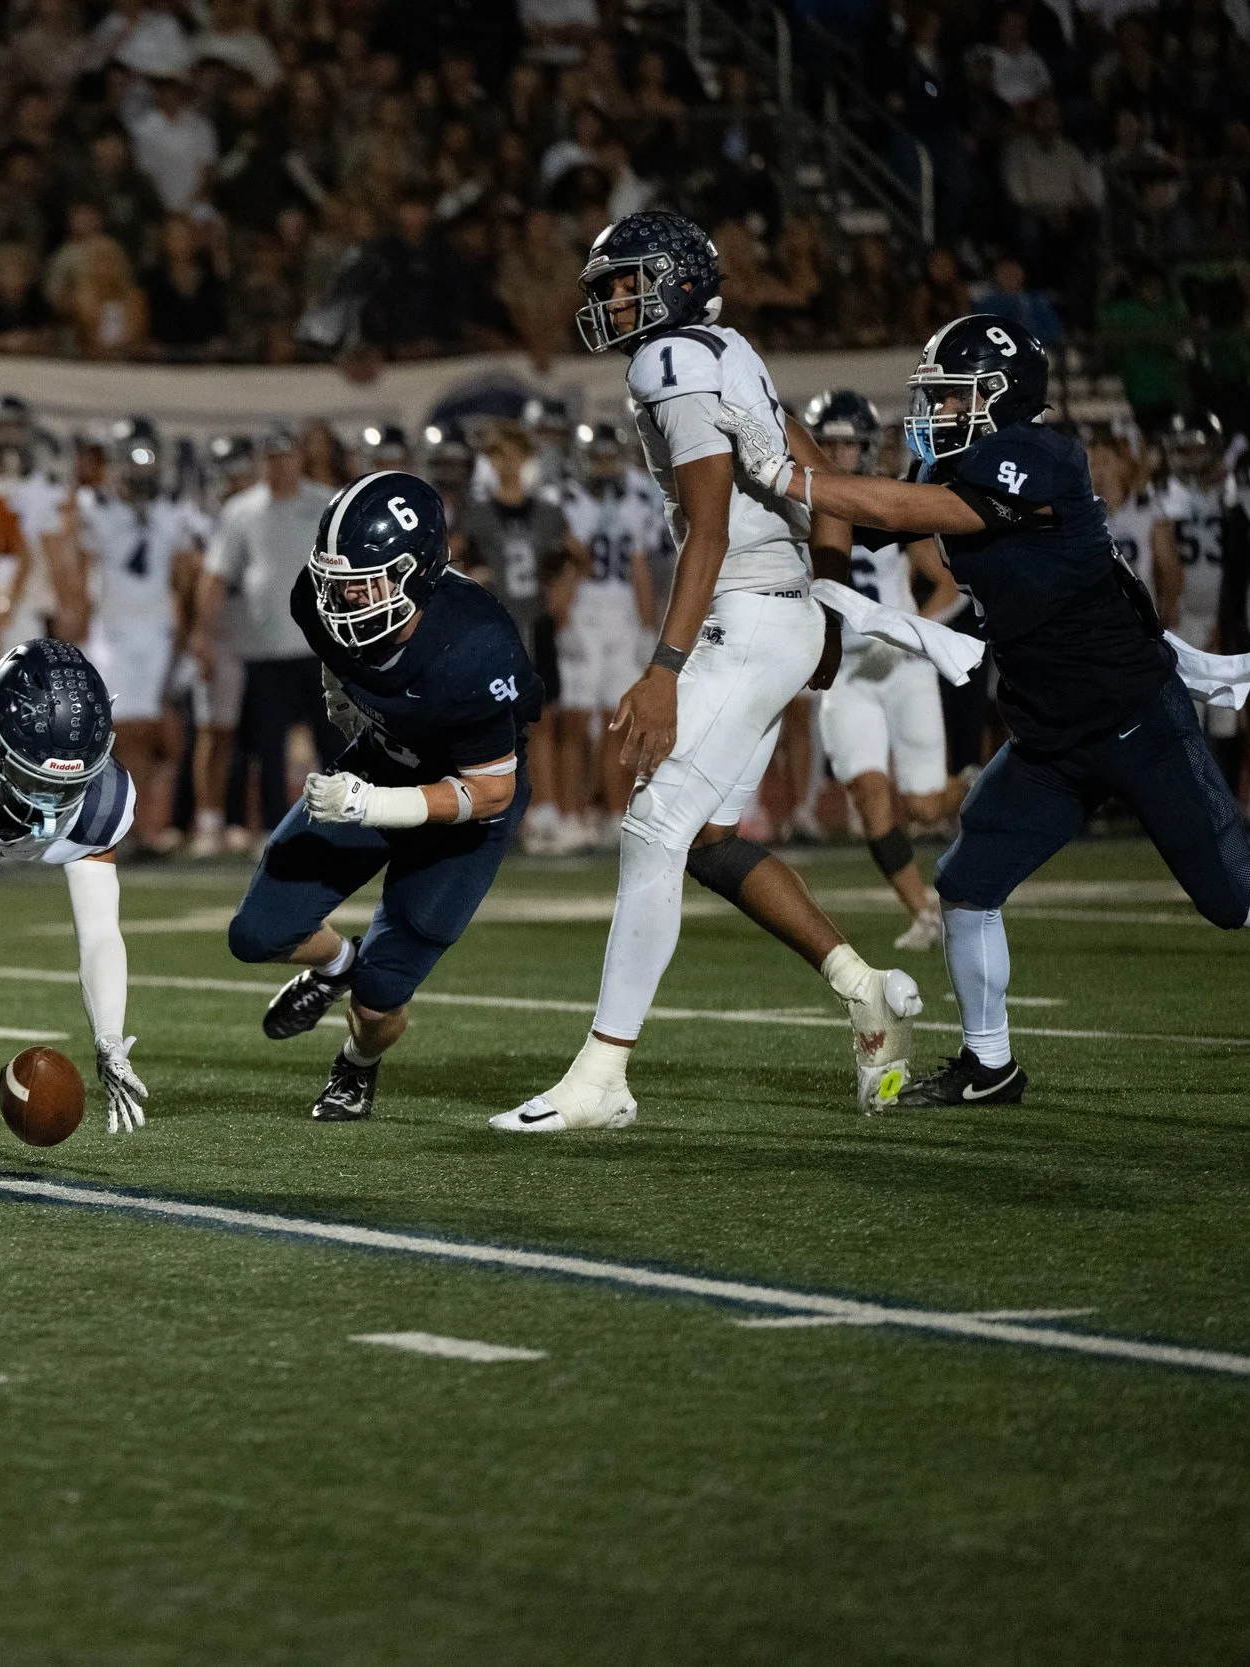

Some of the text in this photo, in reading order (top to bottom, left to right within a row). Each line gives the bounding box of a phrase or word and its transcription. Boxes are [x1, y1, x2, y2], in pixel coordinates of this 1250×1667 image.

[986, 326, 1018, 358] 9
[659, 346, 678, 388] 1
[997, 460, 1028, 495] SV
[387, 496, 419, 531] 6
[489, 675, 519, 702] SV
[49, 761, 82, 771] Riddell
